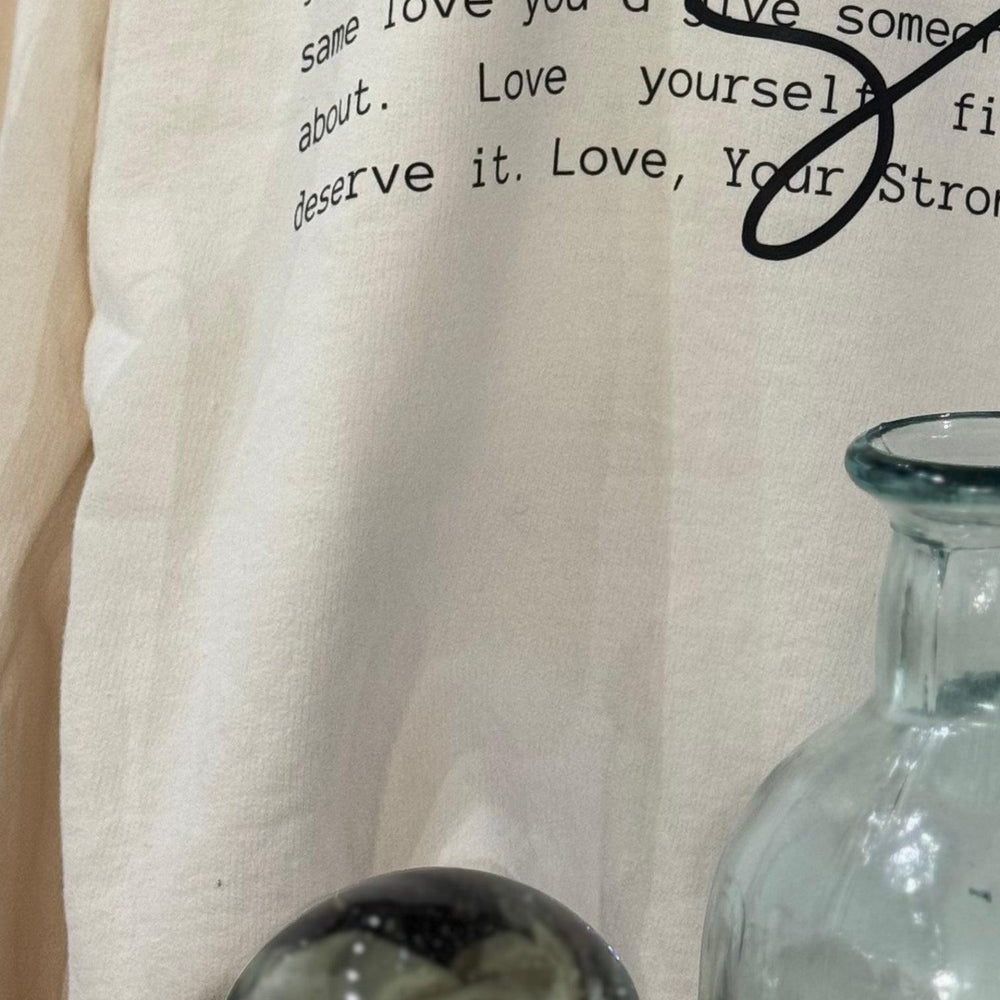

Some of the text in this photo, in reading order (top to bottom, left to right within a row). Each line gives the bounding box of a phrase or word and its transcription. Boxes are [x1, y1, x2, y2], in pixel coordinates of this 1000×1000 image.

[301, 15, 360, 73] same
[299, 78, 388, 152] about.
[479, 62, 567, 102] Love
[294, 161, 434, 231] deserve
[472, 145, 521, 189] it.
[553, 137, 684, 192] Love,
[723, 147, 844, 196] Your
